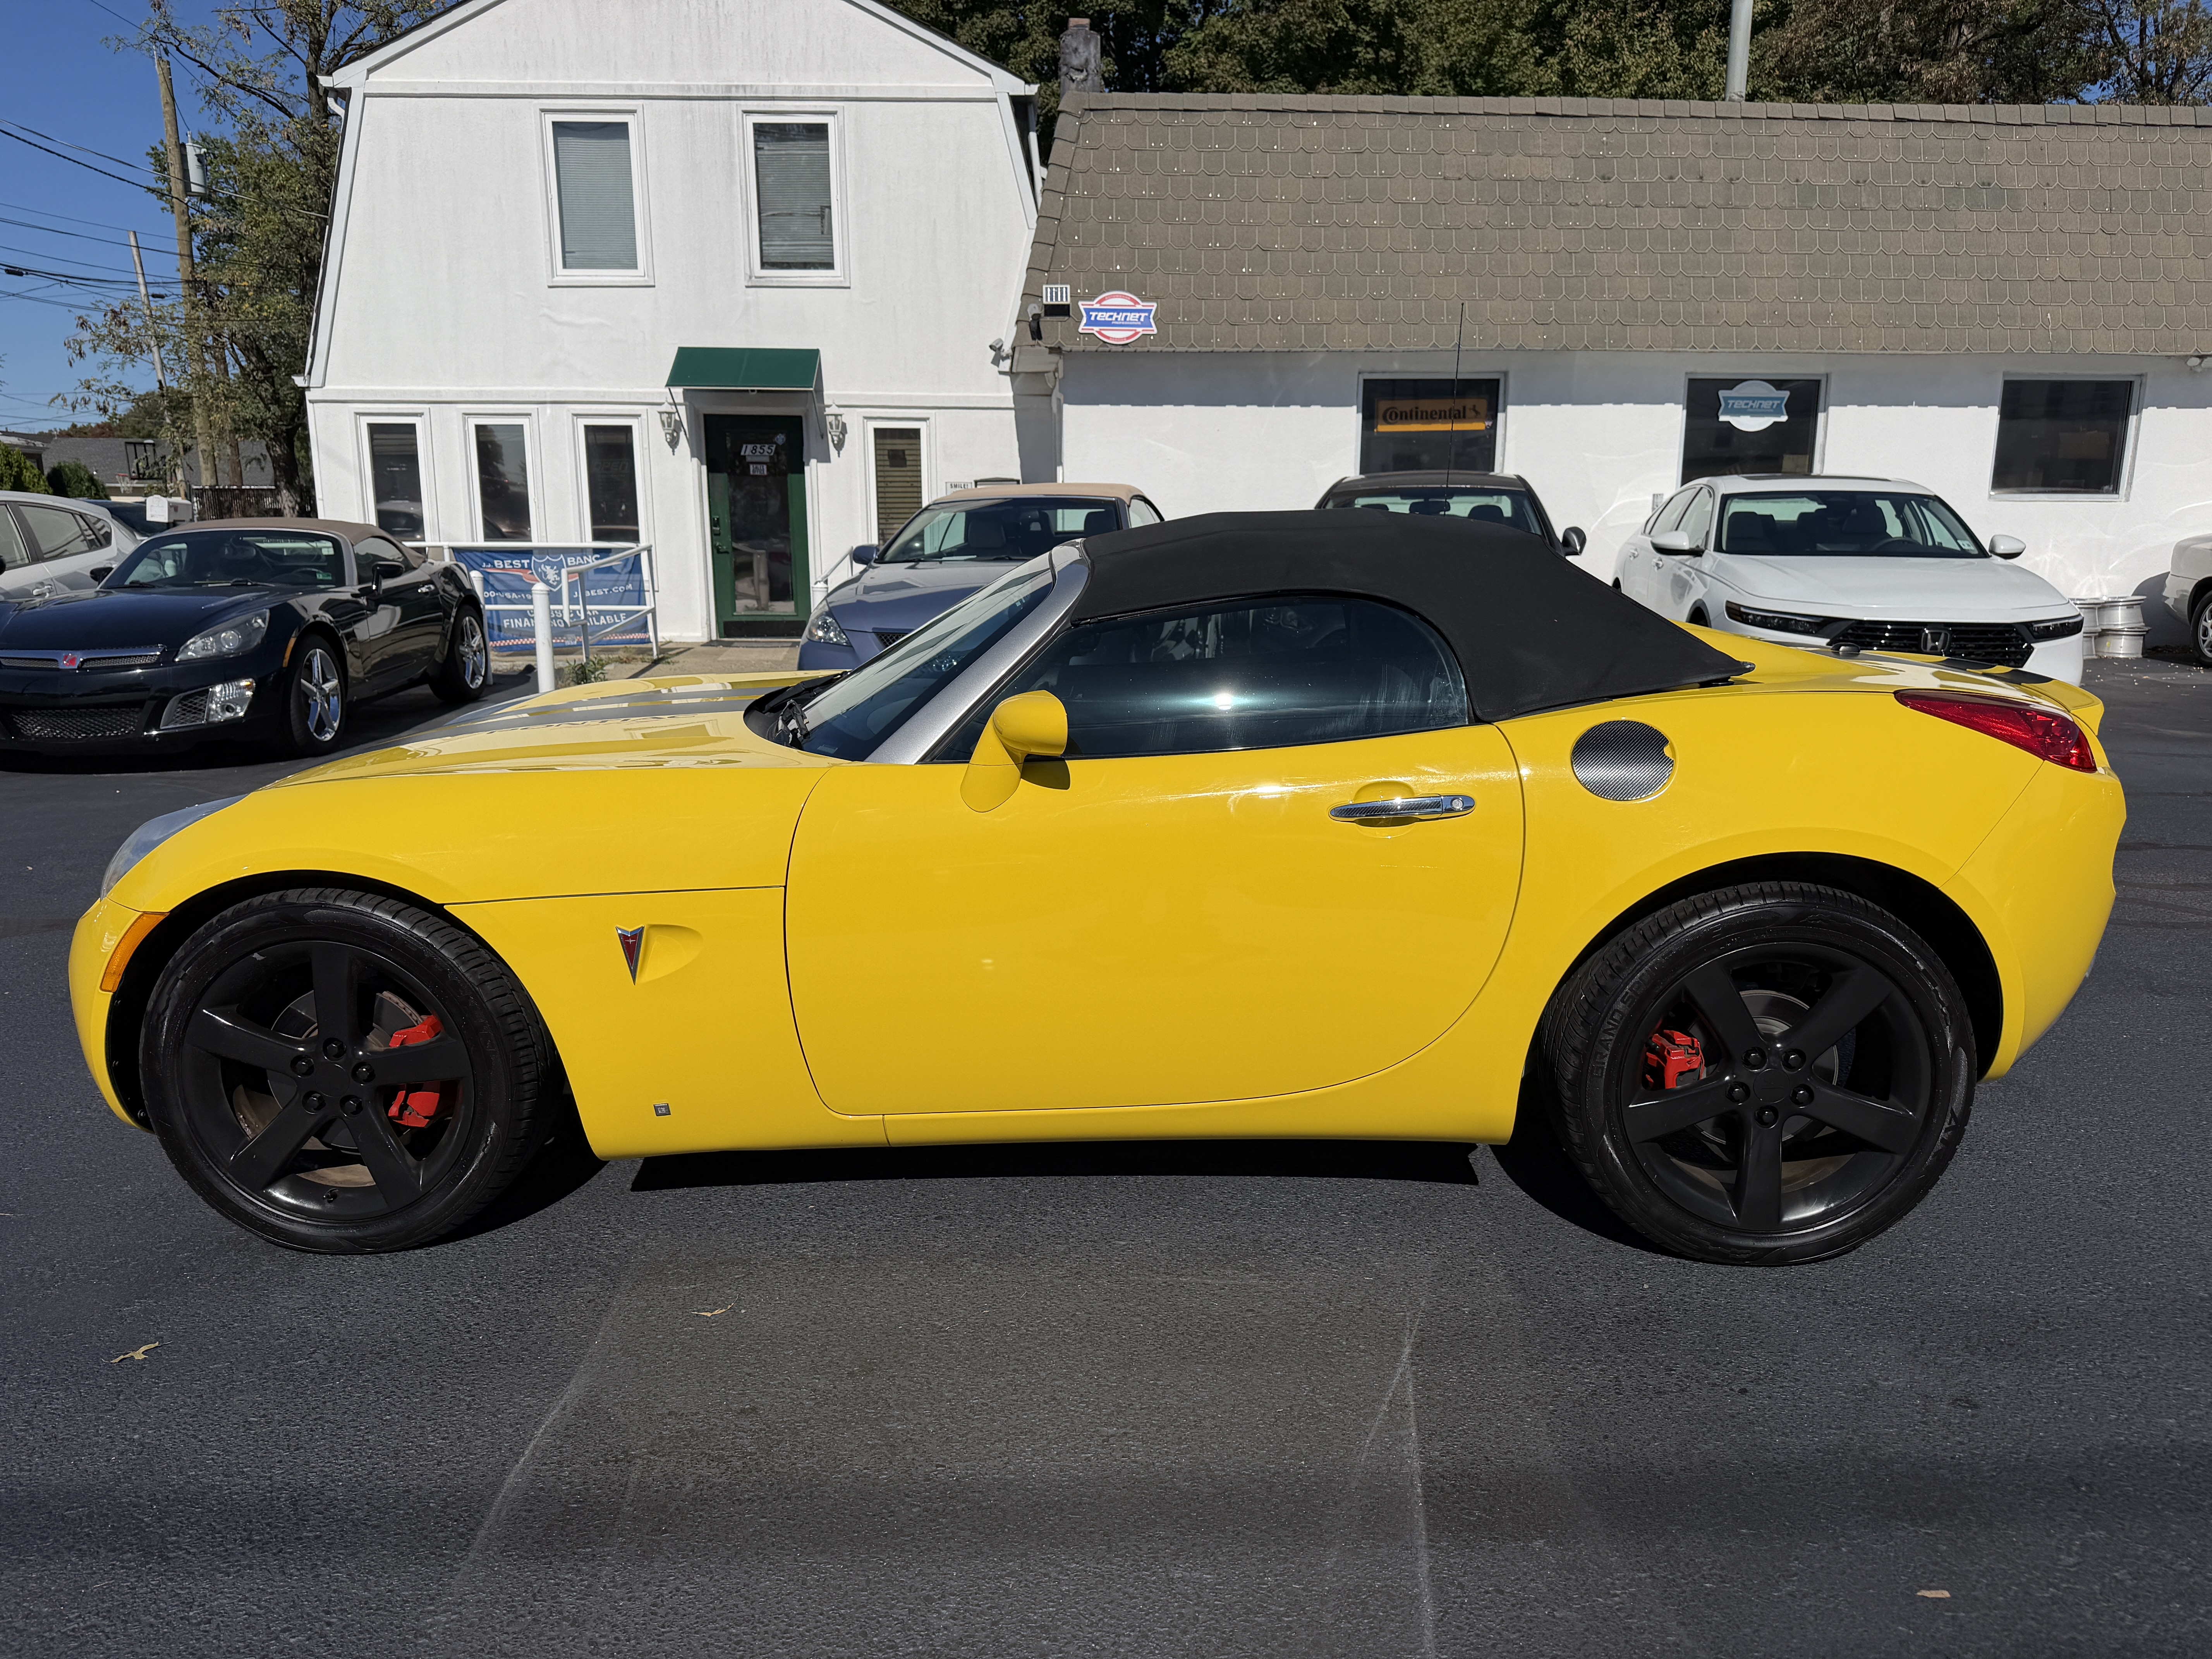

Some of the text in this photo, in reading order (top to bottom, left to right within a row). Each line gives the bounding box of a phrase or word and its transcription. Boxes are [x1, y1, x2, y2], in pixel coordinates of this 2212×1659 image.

[1382, 405, 1467, 424] Continental
[744, 445, 774, 455] 1855
[494, 559, 530, 568] BEST
[567, 554, 600, 566] BANC
[573, 583, 632, 598] JBEST.COM
